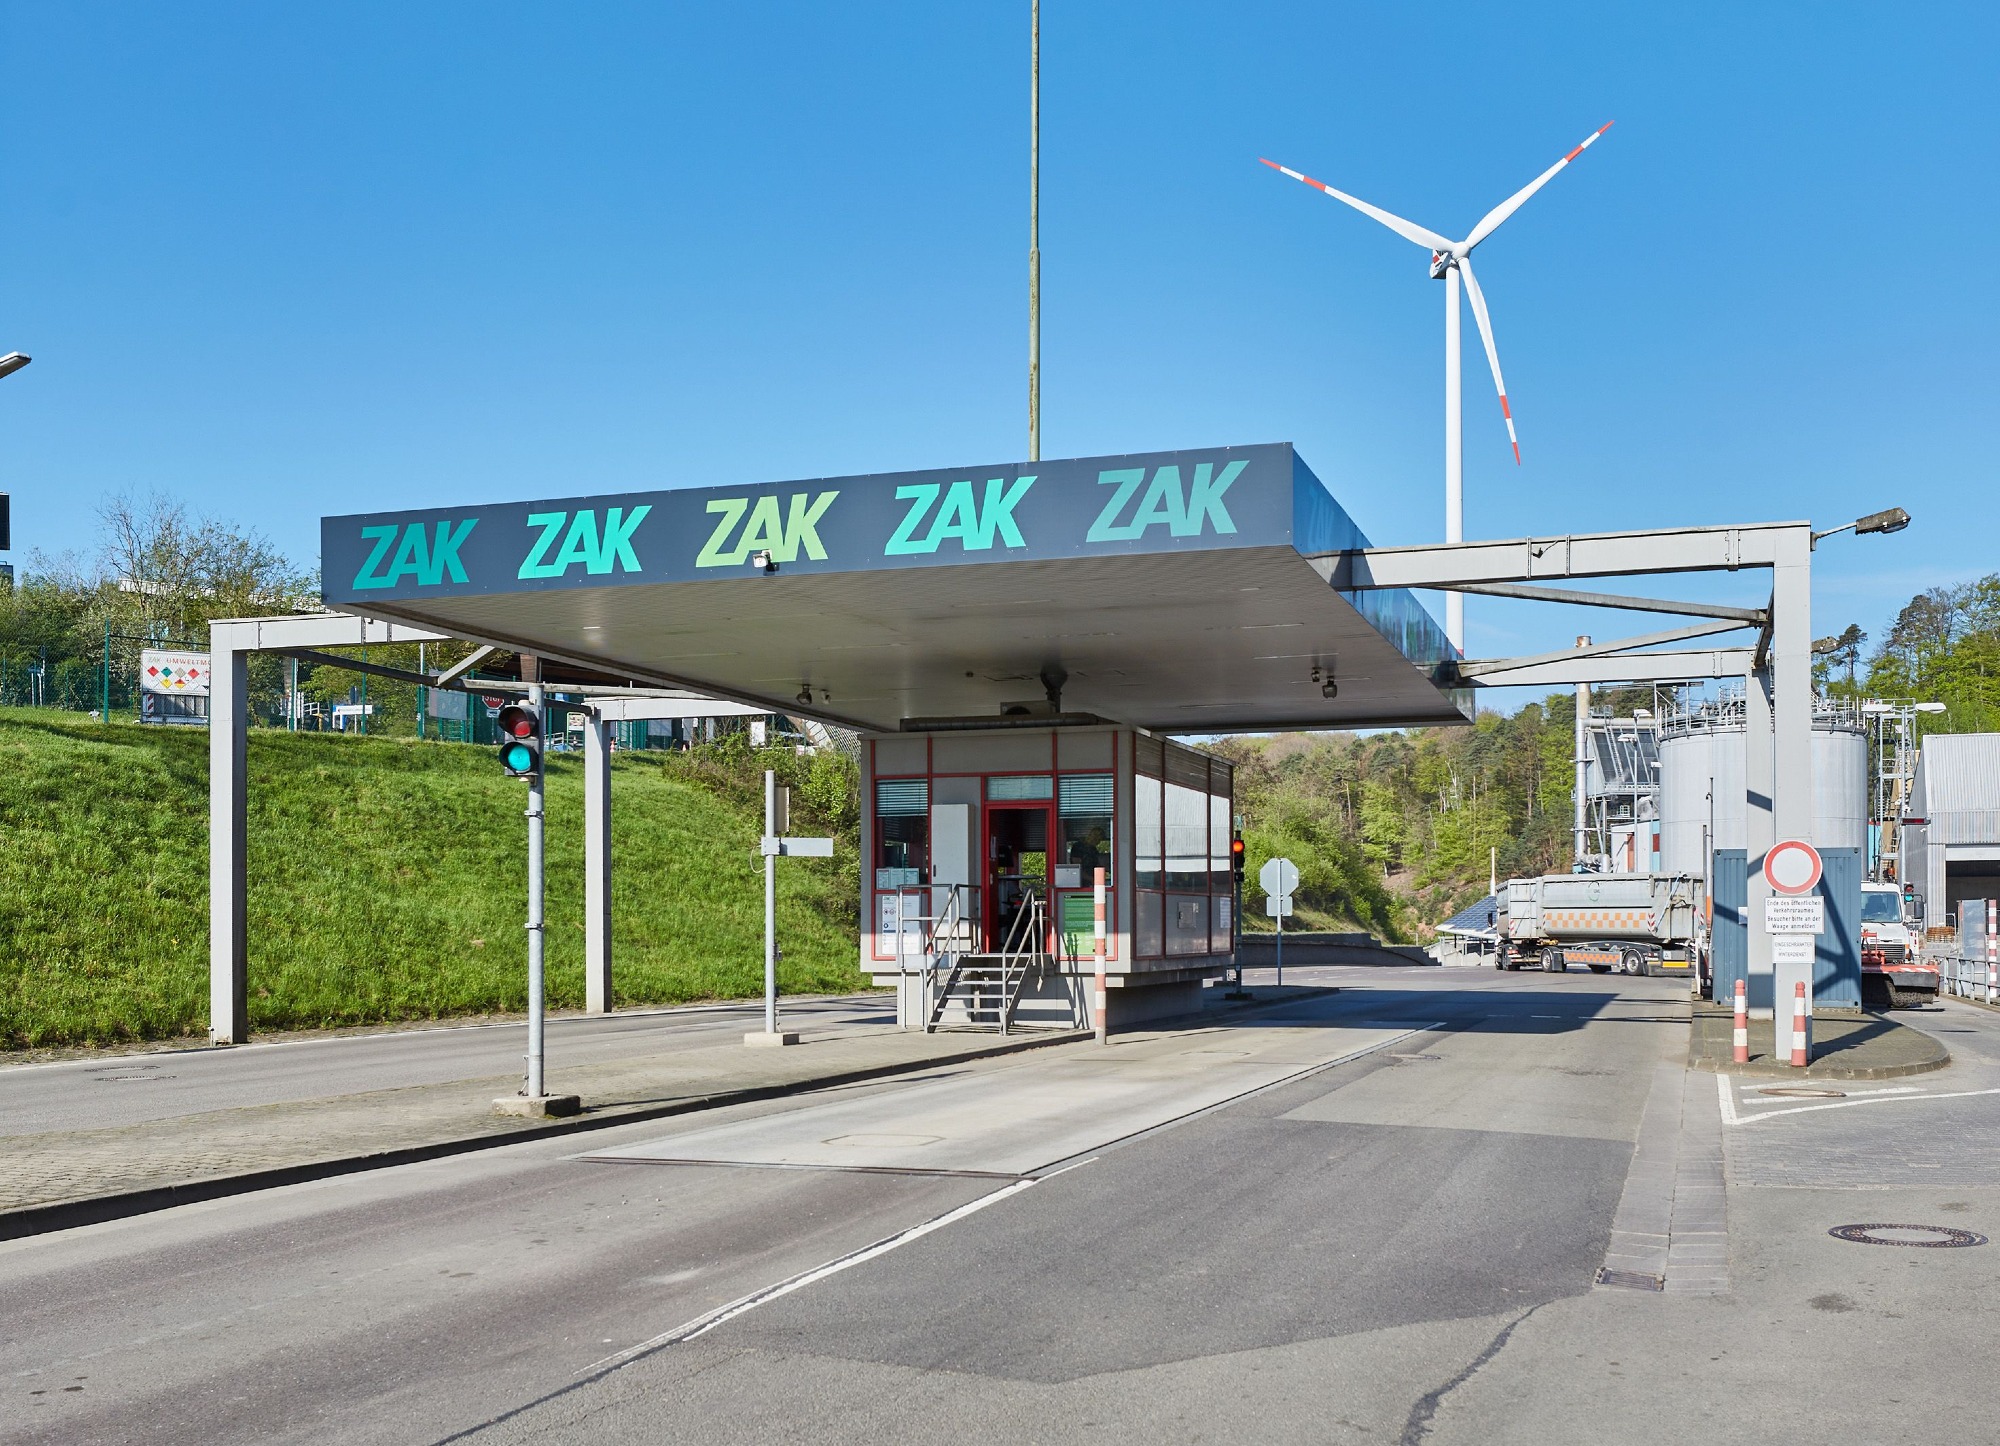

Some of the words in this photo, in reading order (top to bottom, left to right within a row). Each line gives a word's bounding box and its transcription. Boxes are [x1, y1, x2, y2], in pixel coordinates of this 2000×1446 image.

[695, 490, 840, 568] ZAK
[885, 476, 1037, 555] ZAK
[1087, 460, 1249, 542] ZAK
[352, 518, 479, 591] ZAK
[519, 505, 651, 579] ZAK
